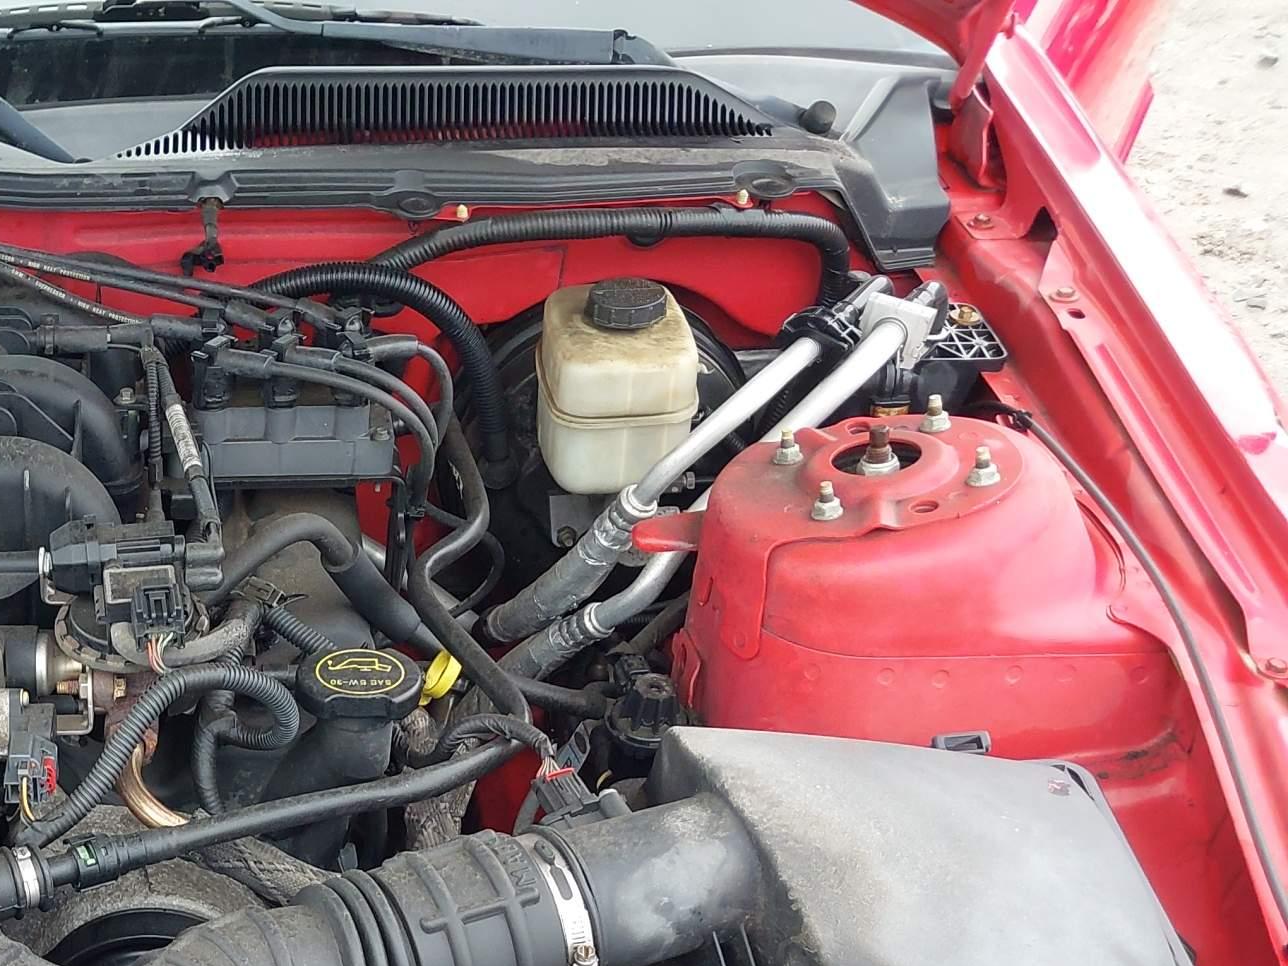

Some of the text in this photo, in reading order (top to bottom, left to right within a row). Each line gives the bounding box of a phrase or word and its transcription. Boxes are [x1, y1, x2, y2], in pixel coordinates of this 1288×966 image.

[43, 265, 57, 273] HEAT
[92, 306, 106, 316] HEAT
[329, 679, 367, 687] 5W-30
